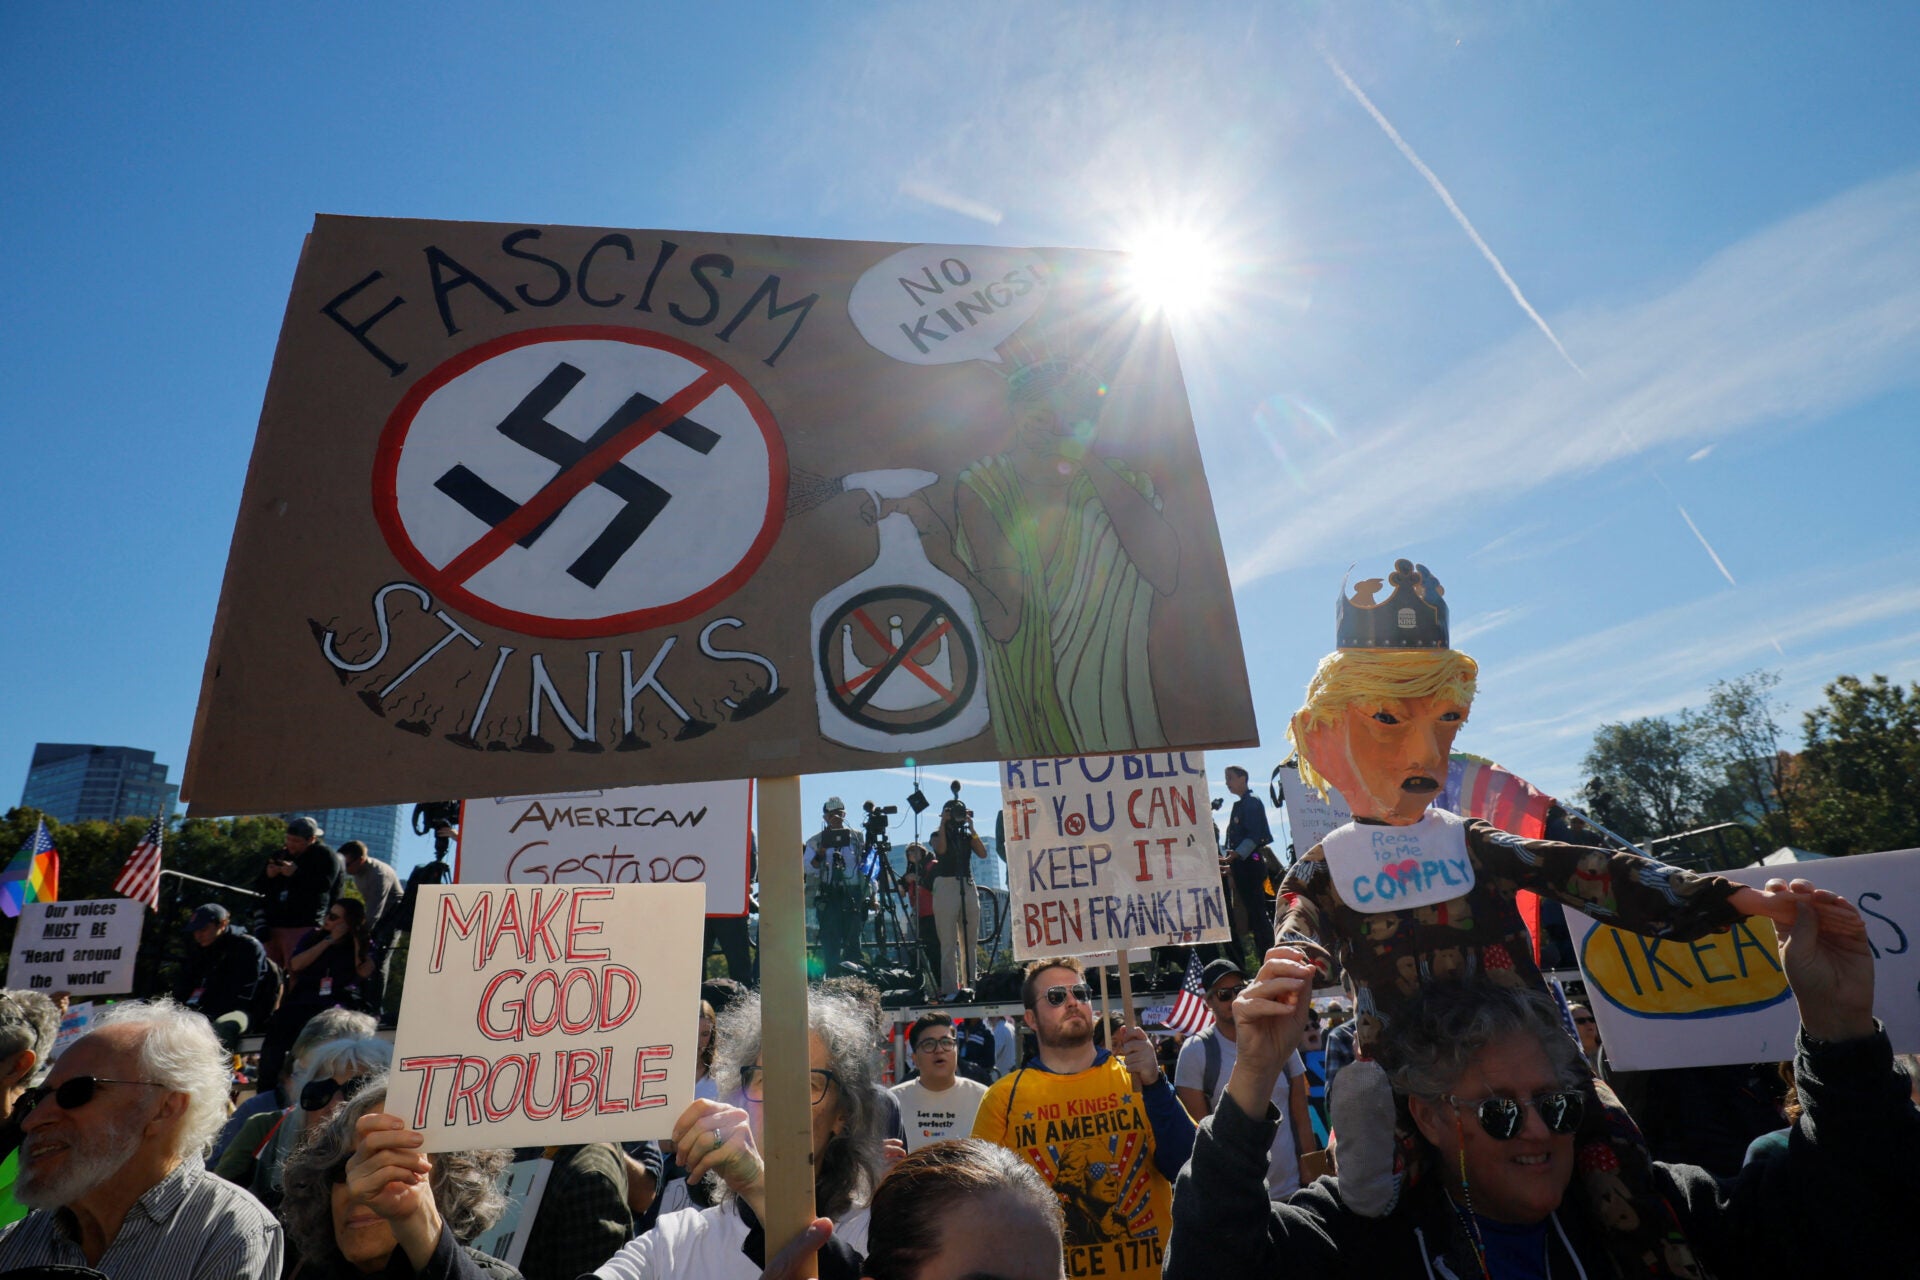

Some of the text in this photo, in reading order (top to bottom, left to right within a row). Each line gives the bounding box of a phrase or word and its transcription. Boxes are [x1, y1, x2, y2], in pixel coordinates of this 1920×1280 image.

[320, 228, 820, 378] FASCISM
[898, 258, 971, 307] NO
[899, 264, 1047, 354] KINGS!
[321, 580, 780, 742] STINKS
[509, 801, 707, 834] AMERICAN
[1007, 785, 1197, 841] IF YOU CAN
[1027, 843, 1112, 892] KEEP
[1374, 849, 1391, 861] to
[1352, 857, 1470, 903] COMPLY
[42, 922, 108, 938] MUST BE
[45, 902, 117, 918] Our voices
[429, 887, 615, 974] MAKE
[1023, 886, 1225, 948] BEN FRANKLIN
[73, 946, 122, 961] around
[1610, 922, 1784, 996] IKEA
[30, 974, 52, 988] the
[477, 964, 641, 1041] GOOD
[400, 1045, 673, 1130] TROUBLE
[1037, 1093, 1119, 1121] NO KINGS
[1015, 1107, 1145, 1148] IN AMERICA
[1114, 1237, 1163, 1273] 1776
